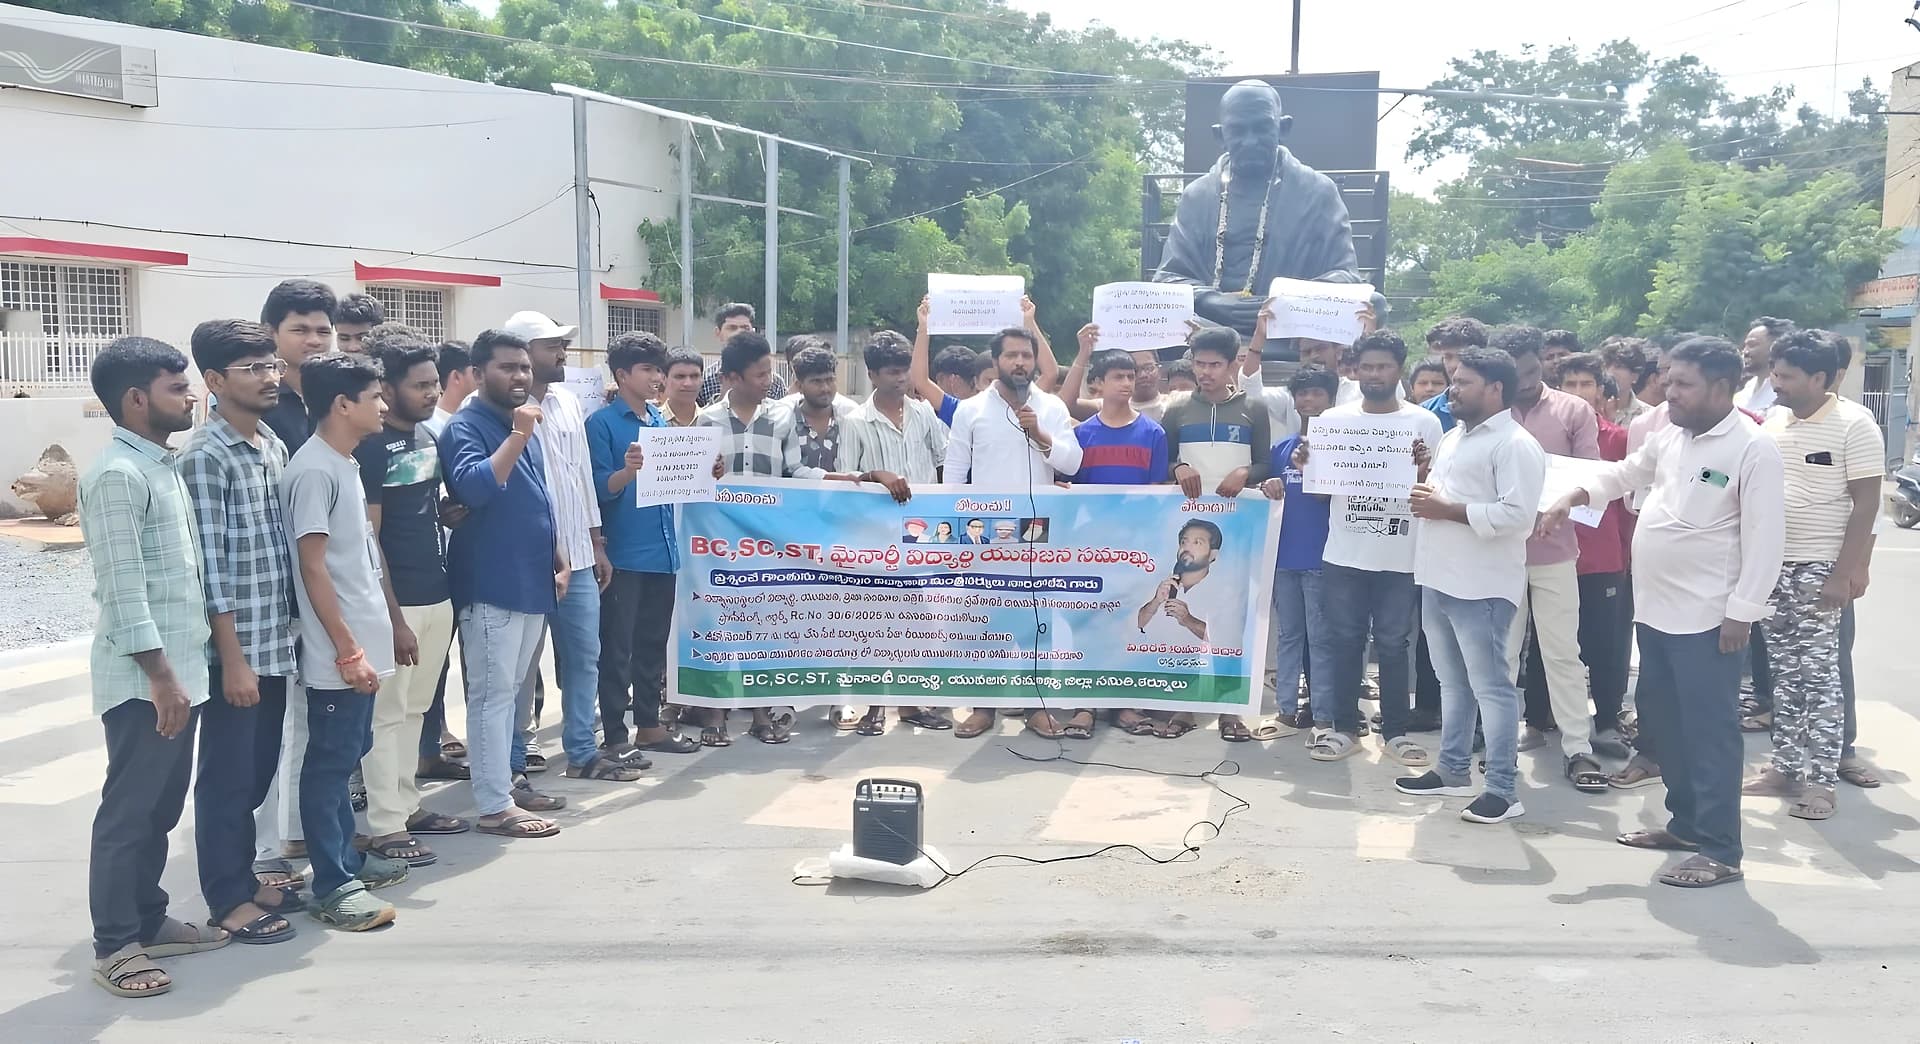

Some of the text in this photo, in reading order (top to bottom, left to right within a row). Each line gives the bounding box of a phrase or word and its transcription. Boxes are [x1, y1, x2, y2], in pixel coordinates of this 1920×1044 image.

[691, 536, 824, 563] BC,SC,ST,
[980, 547, 1072, 564] యువజన
[1077, 547, 1157, 573] సమాఖ్య
[755, 632, 768, 641] 77
[743, 671, 831, 687] BC,SC,ST,
